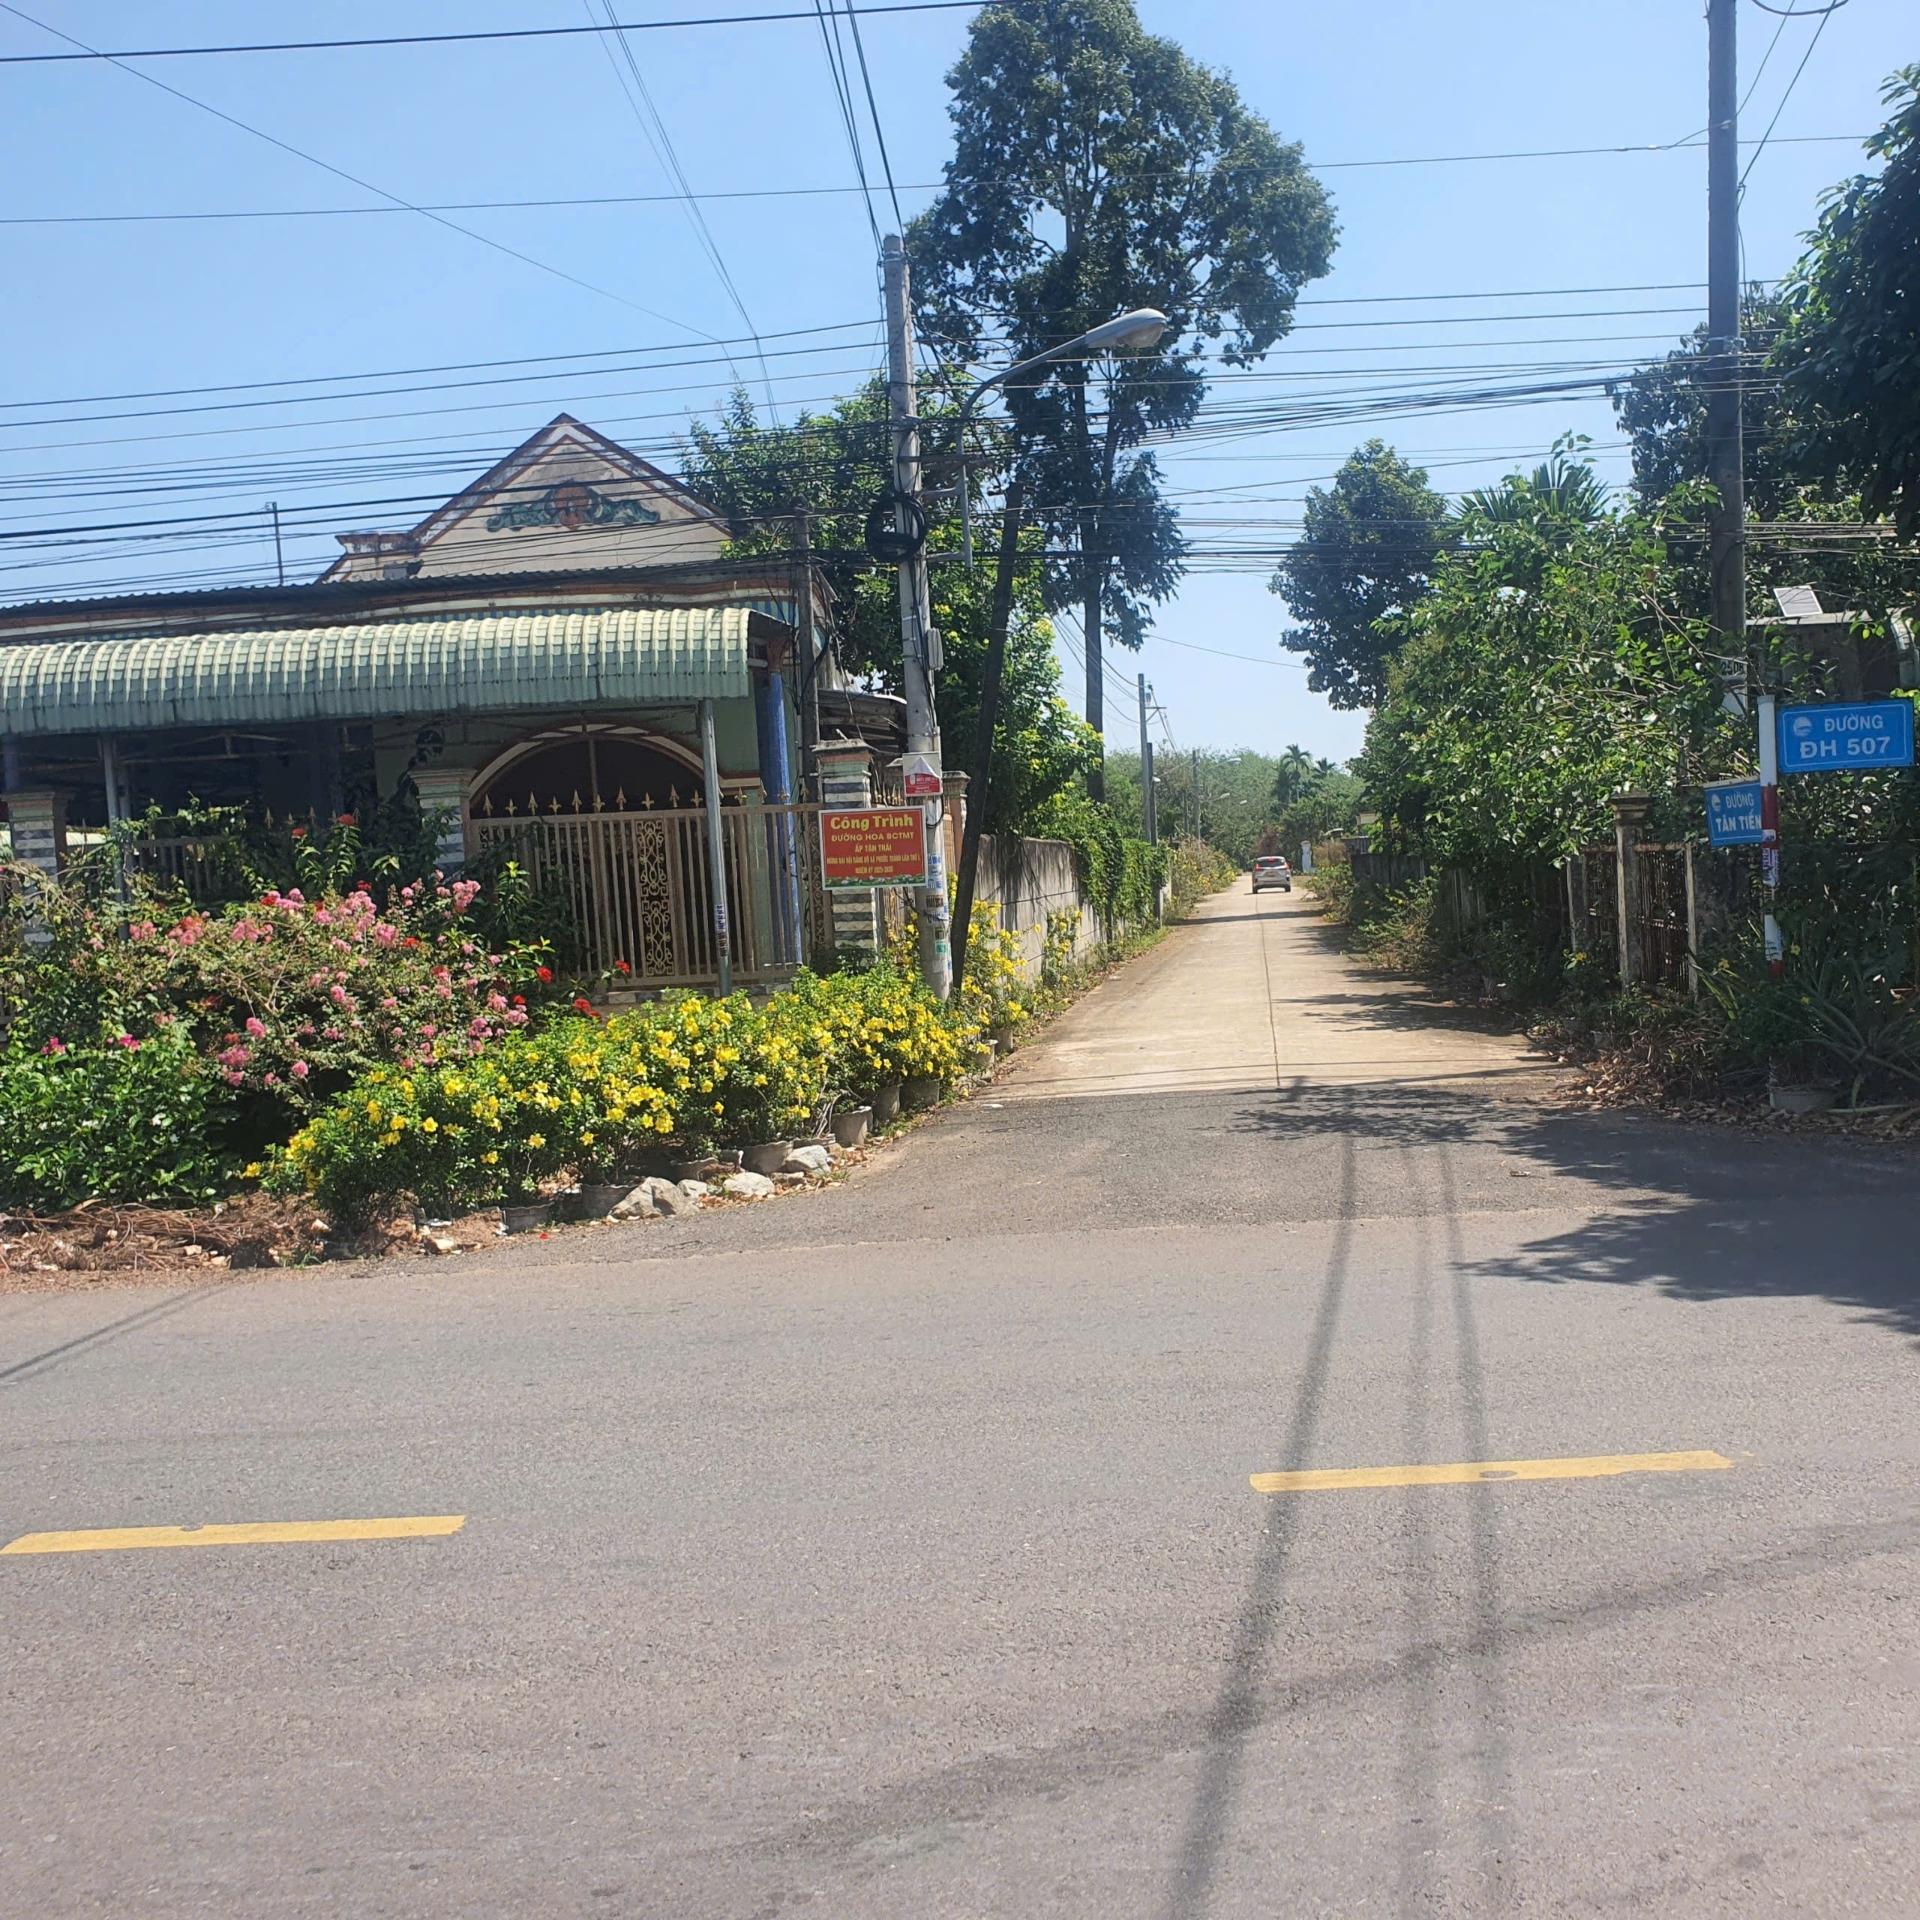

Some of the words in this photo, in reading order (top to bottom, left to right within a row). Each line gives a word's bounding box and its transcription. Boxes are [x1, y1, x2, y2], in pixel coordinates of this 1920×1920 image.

[1824, 714, 1883, 732] ĐƯỜNG
[1800, 739, 1837, 759] ĐH
[1847, 736, 1891, 755] 507
[1725, 792, 1755, 809] ĐƯỜNG
[830, 817, 870, 831] Công
[872, 814, 914, 827] Trình
[1715, 814, 1737, 832] TÂN
[1737, 808, 1761, 831] TIẾN
[831, 833, 863, 842] ĐƯỜNG
[865, 833, 885, 841] HOA
